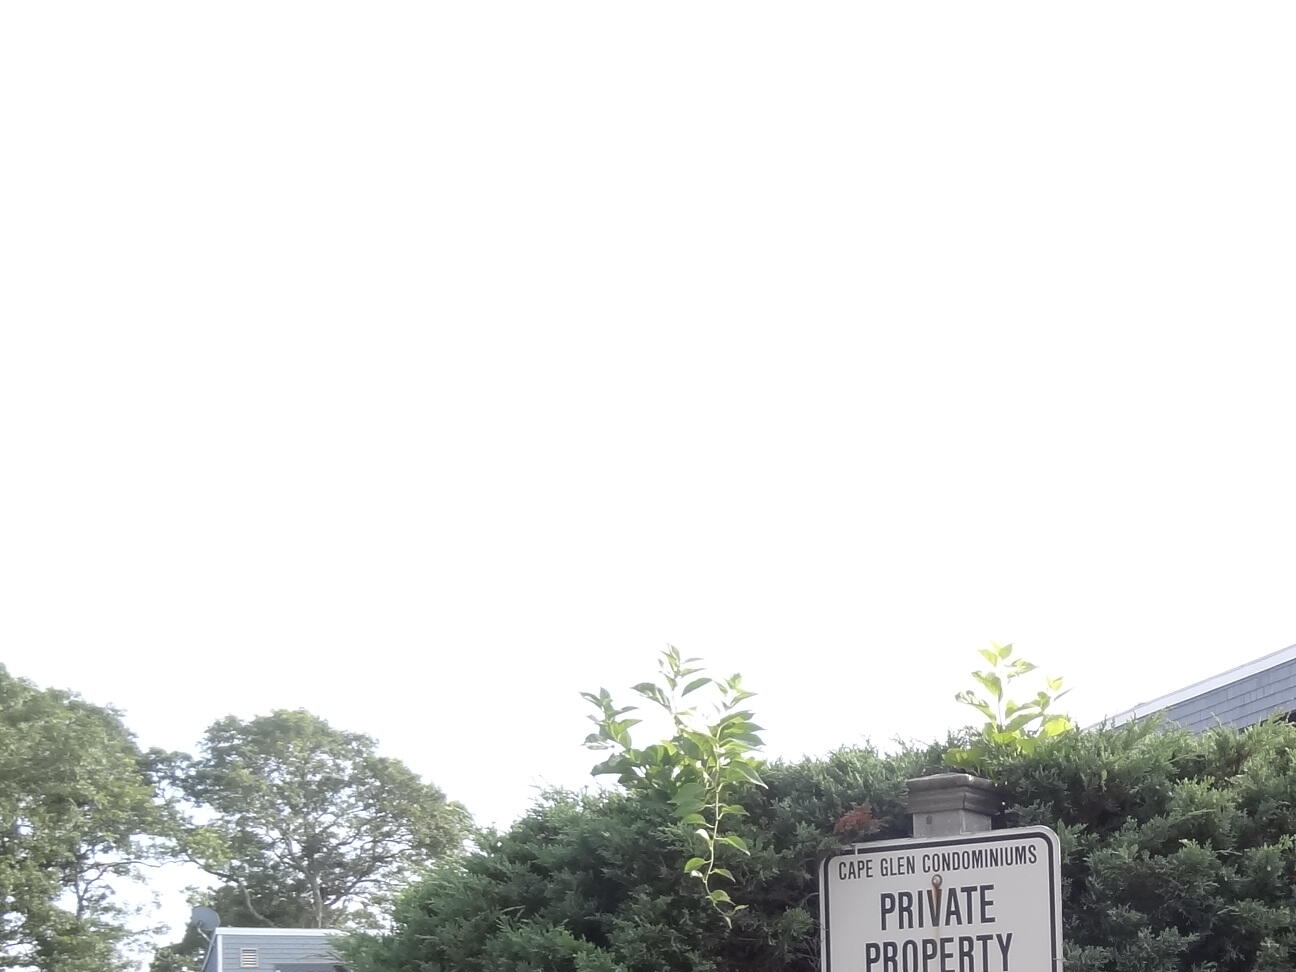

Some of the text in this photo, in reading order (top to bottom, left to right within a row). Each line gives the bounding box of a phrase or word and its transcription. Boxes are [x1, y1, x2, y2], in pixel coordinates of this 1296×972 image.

[839, 844, 1038, 881] CAPE GLEN CONDOMINIUMS
[880, 884, 996, 931] PRIVATE
